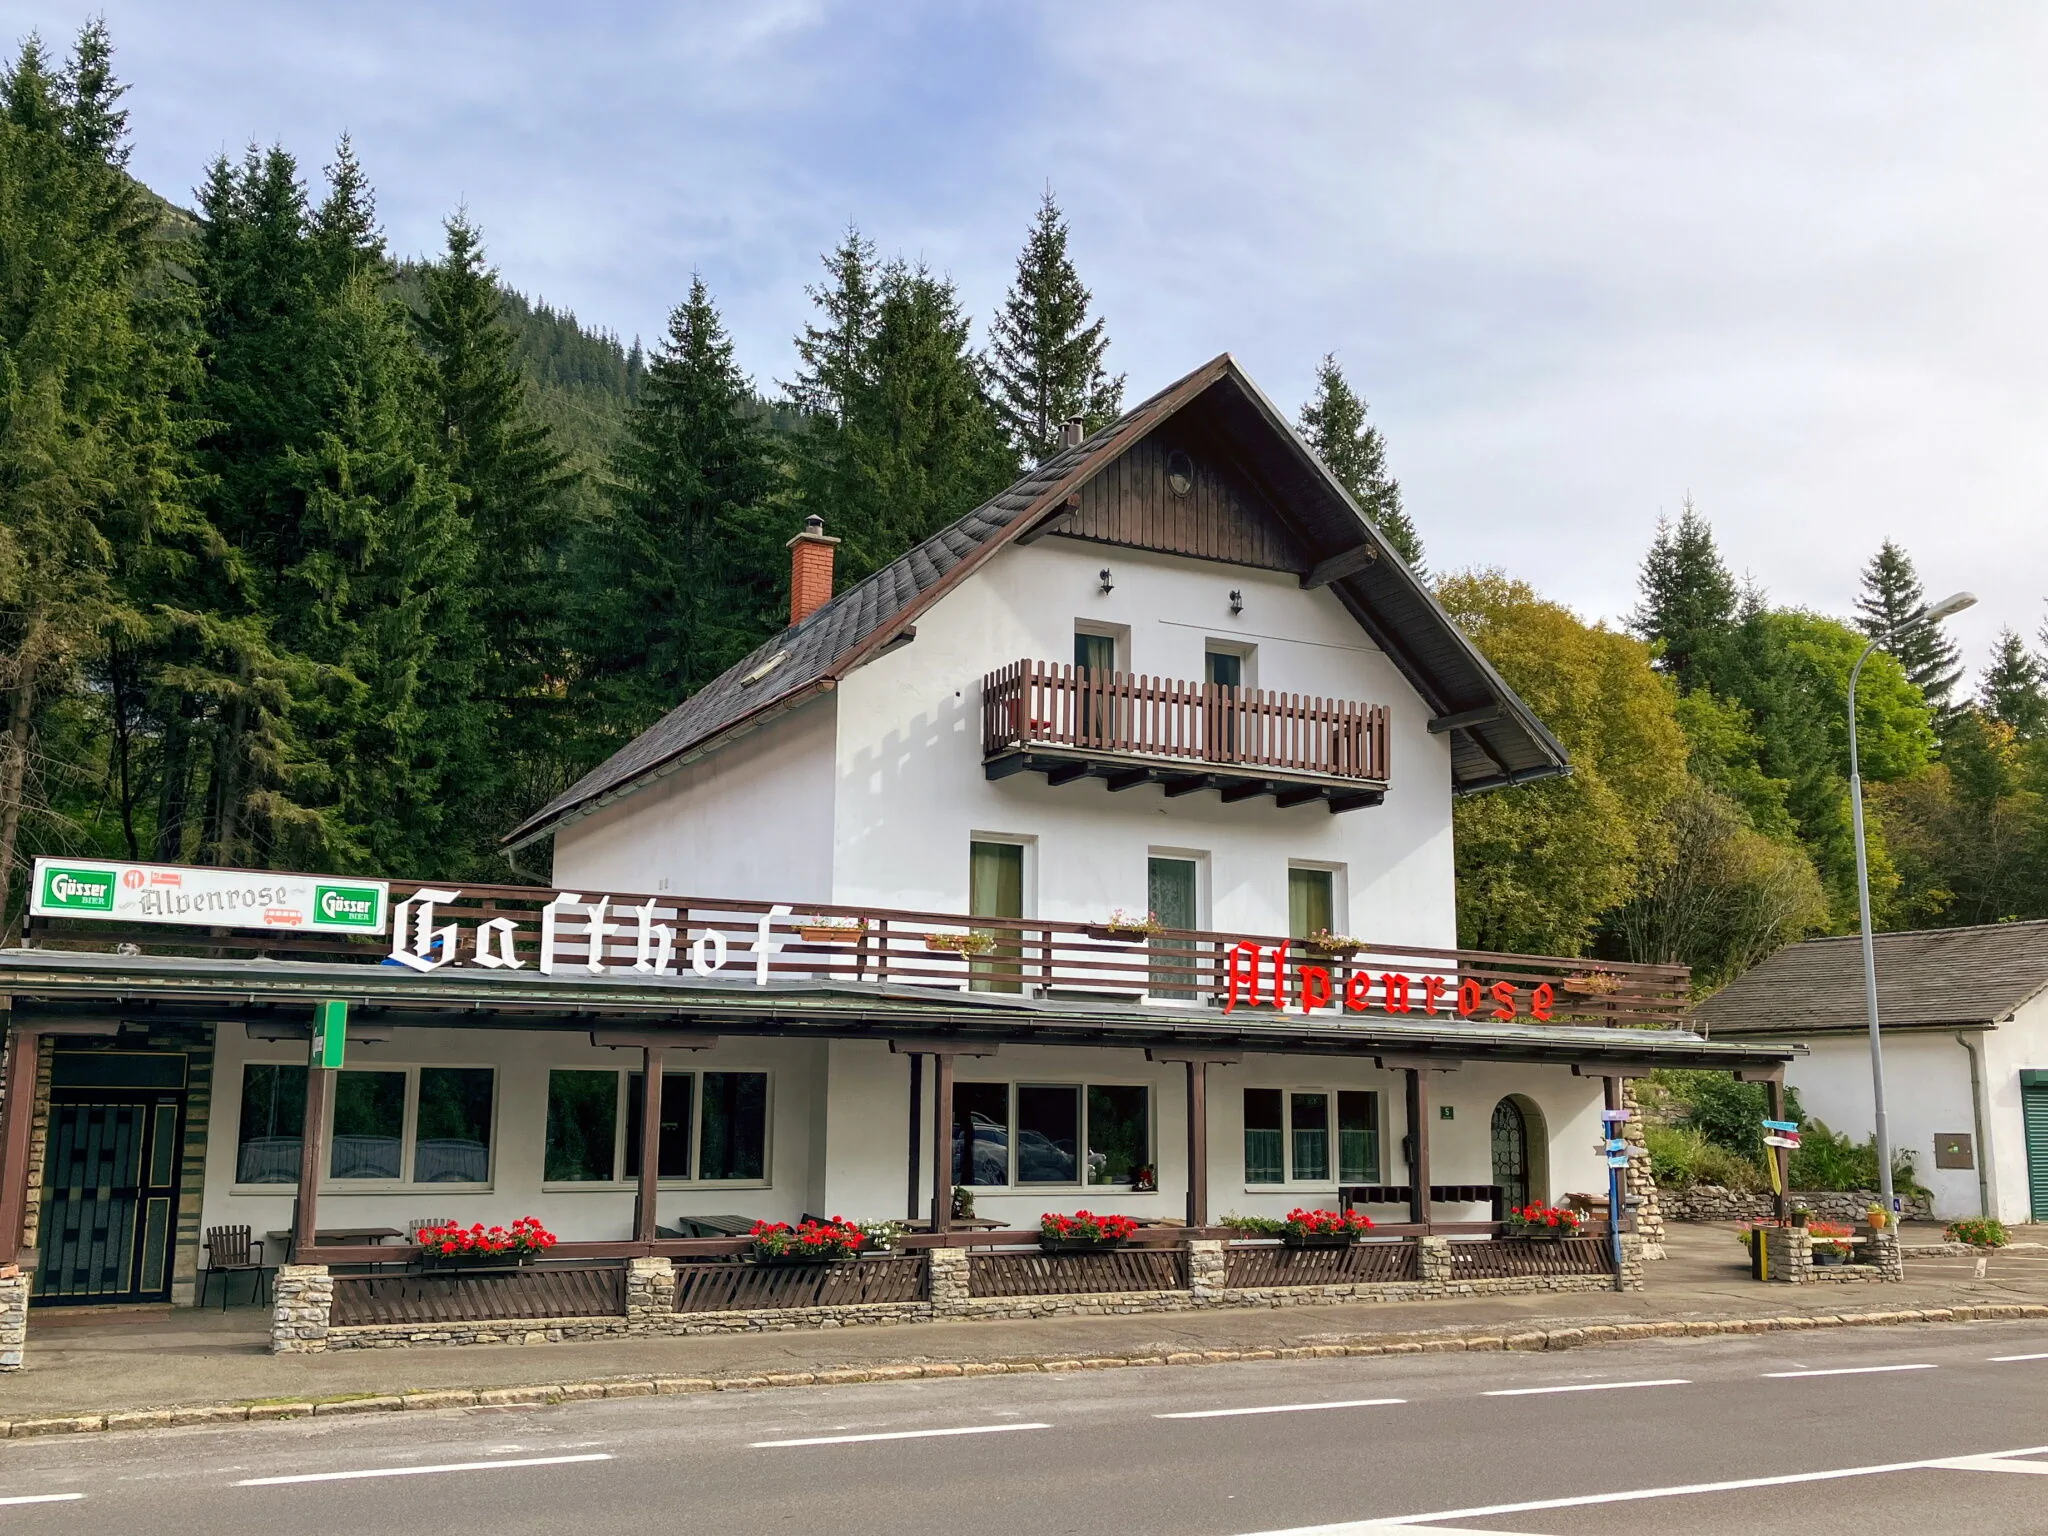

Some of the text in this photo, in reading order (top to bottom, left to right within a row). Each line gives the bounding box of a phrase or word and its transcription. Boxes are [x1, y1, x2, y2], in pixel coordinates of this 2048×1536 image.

[51, 873, 108, 903] Gösser
[81, 896, 105, 905] BIER
[139, 886, 287, 915] Alpenrose
[321, 891, 372, 919] Gösser
[348, 913, 370, 921] BIER
[1222, 939, 1554, 1022] Alpenrose
